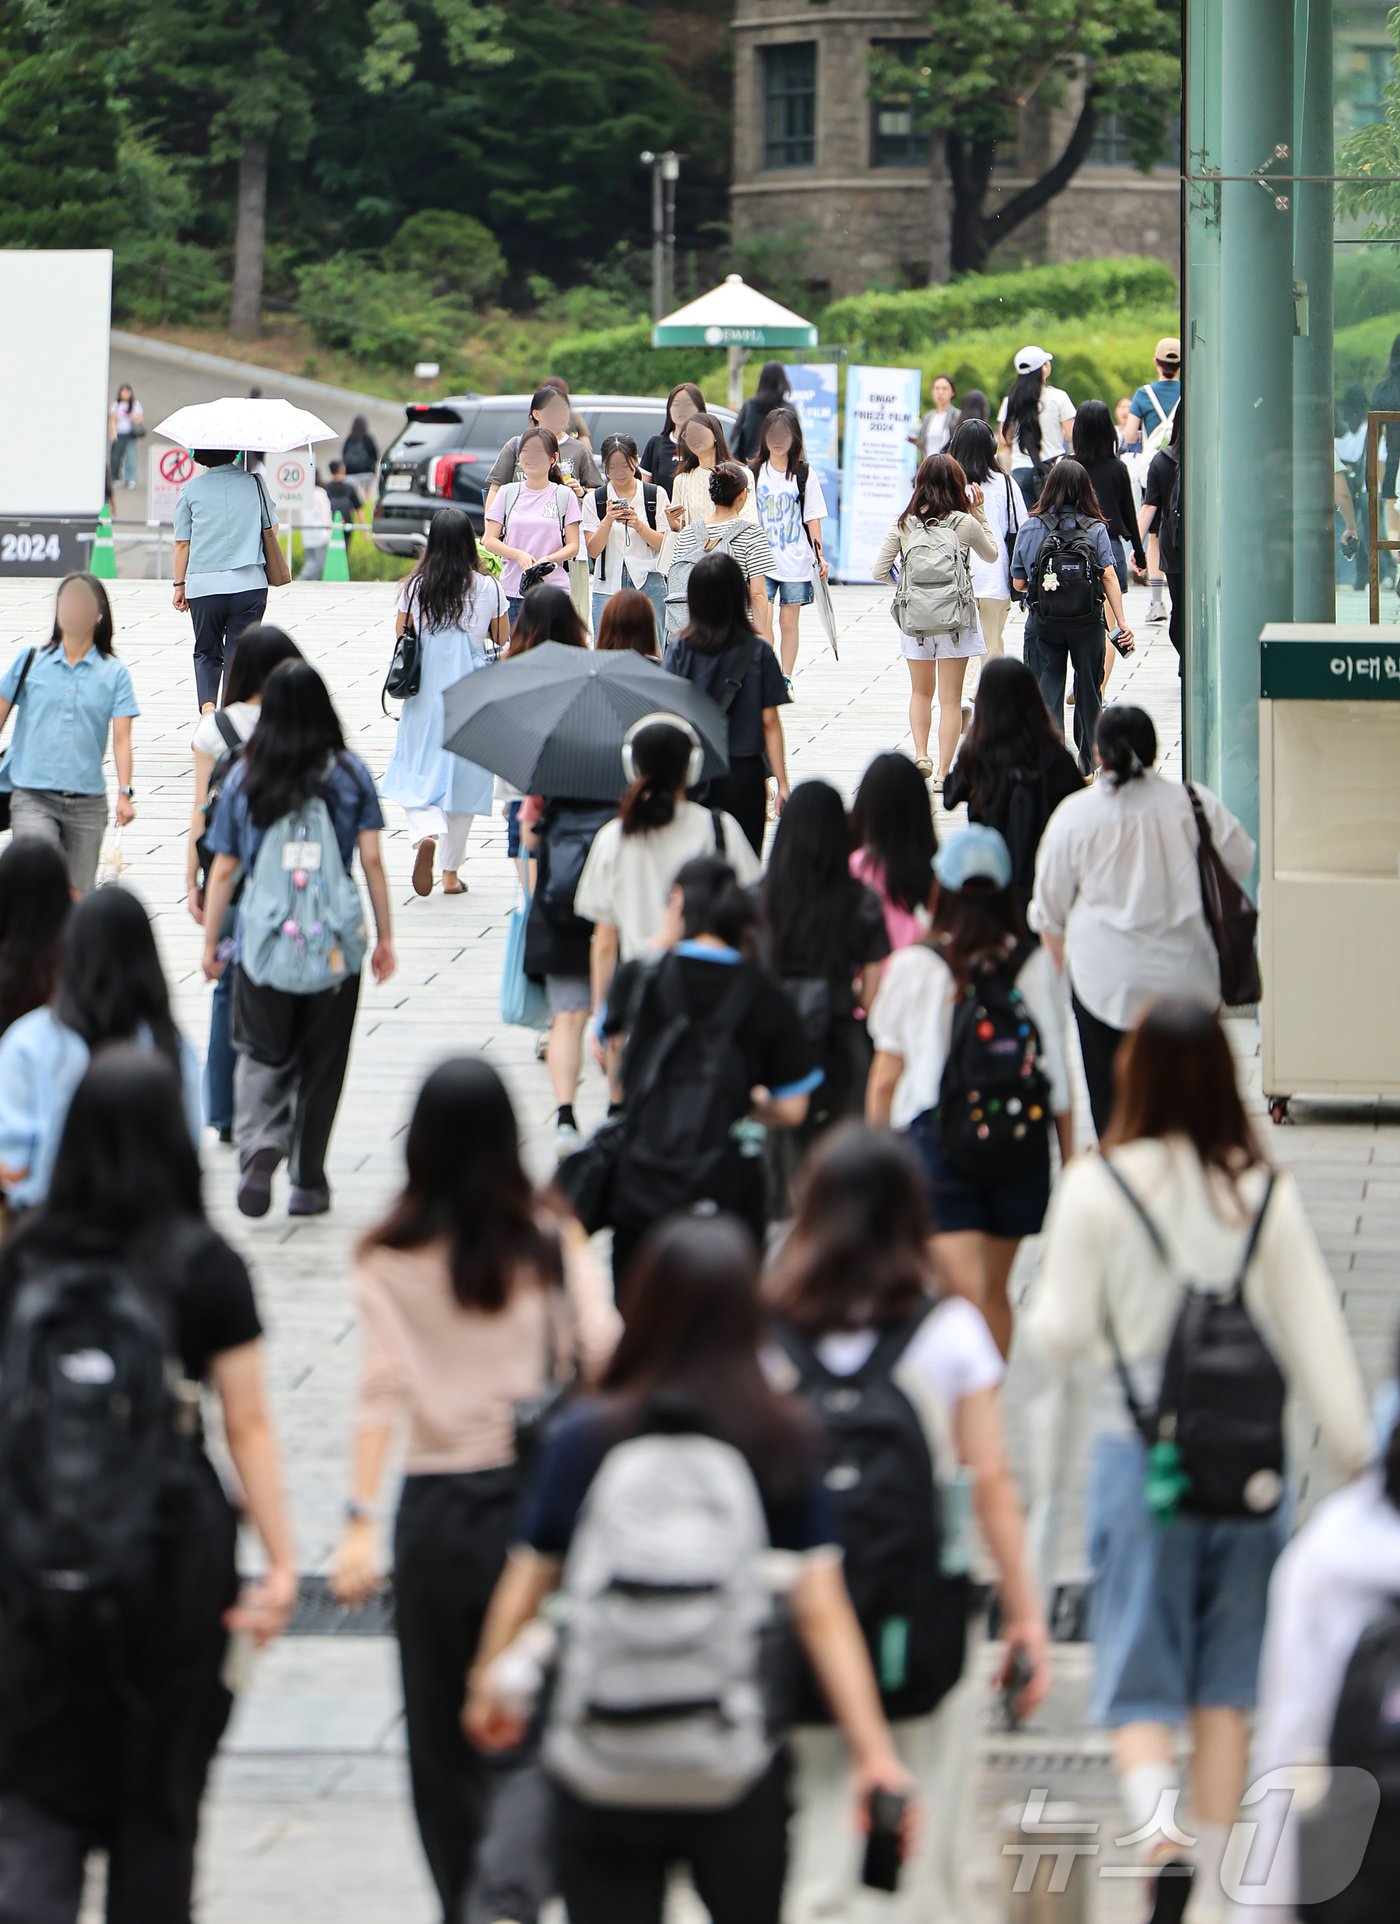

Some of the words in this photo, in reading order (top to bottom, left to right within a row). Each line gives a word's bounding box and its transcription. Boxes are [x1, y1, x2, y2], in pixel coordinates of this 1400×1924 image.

[870, 422, 894, 431] 2024
[282, 468, 300, 482] 20
[544, 501, 558, 518] NY
[1, 533, 60, 562] 2024
